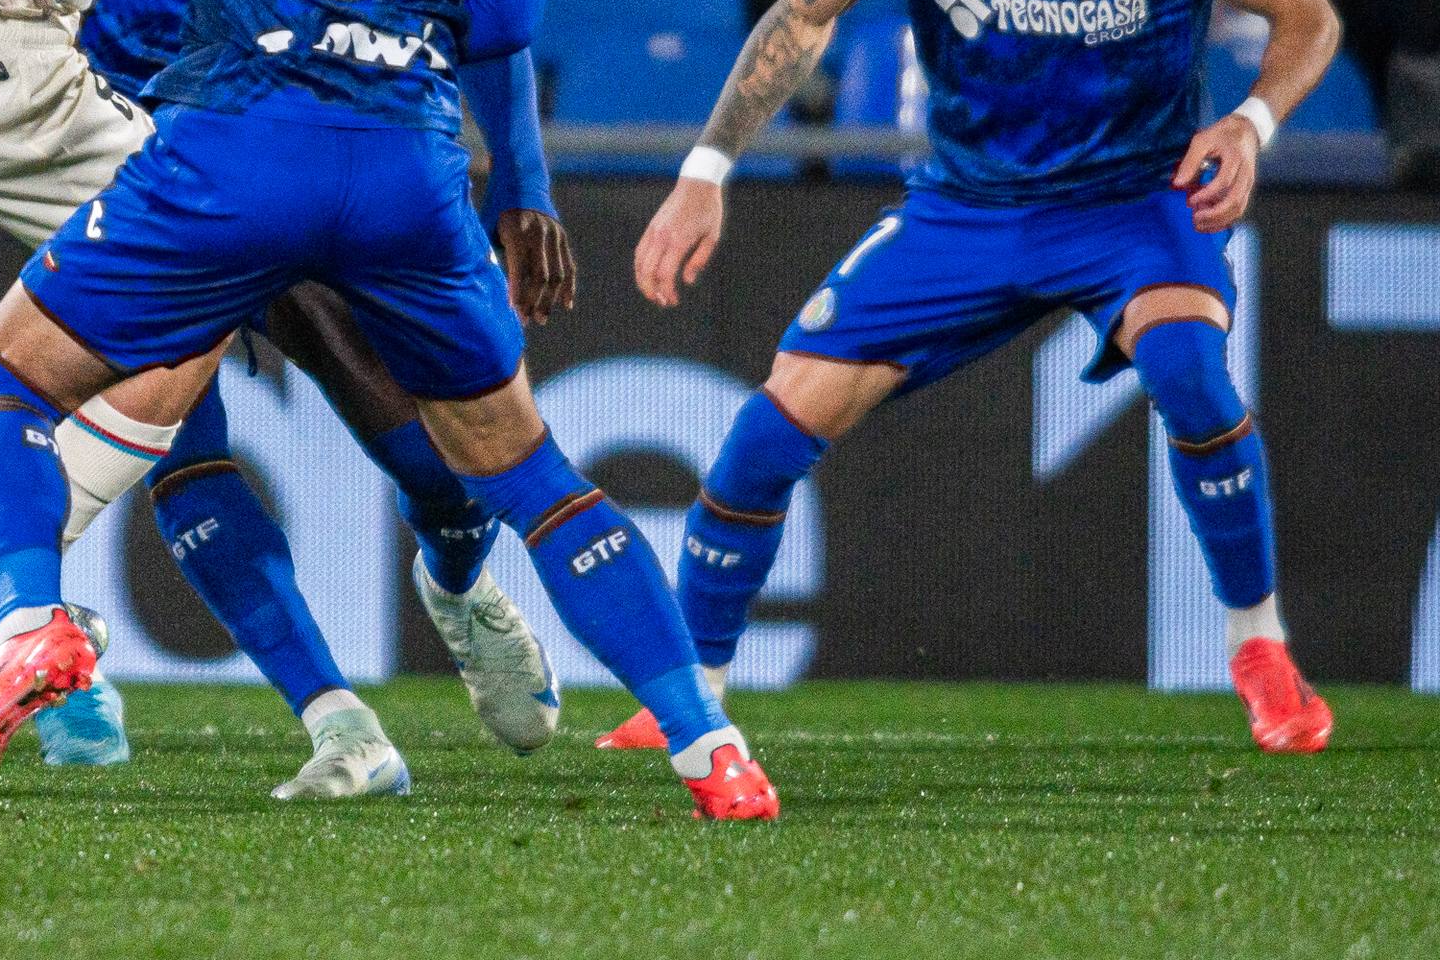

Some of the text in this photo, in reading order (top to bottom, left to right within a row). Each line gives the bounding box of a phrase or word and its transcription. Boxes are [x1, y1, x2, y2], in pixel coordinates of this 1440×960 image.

[1084, 20, 1147, 46] GROUP
[172, 518, 220, 560] GTF
[572, 531, 627, 573] GTF
